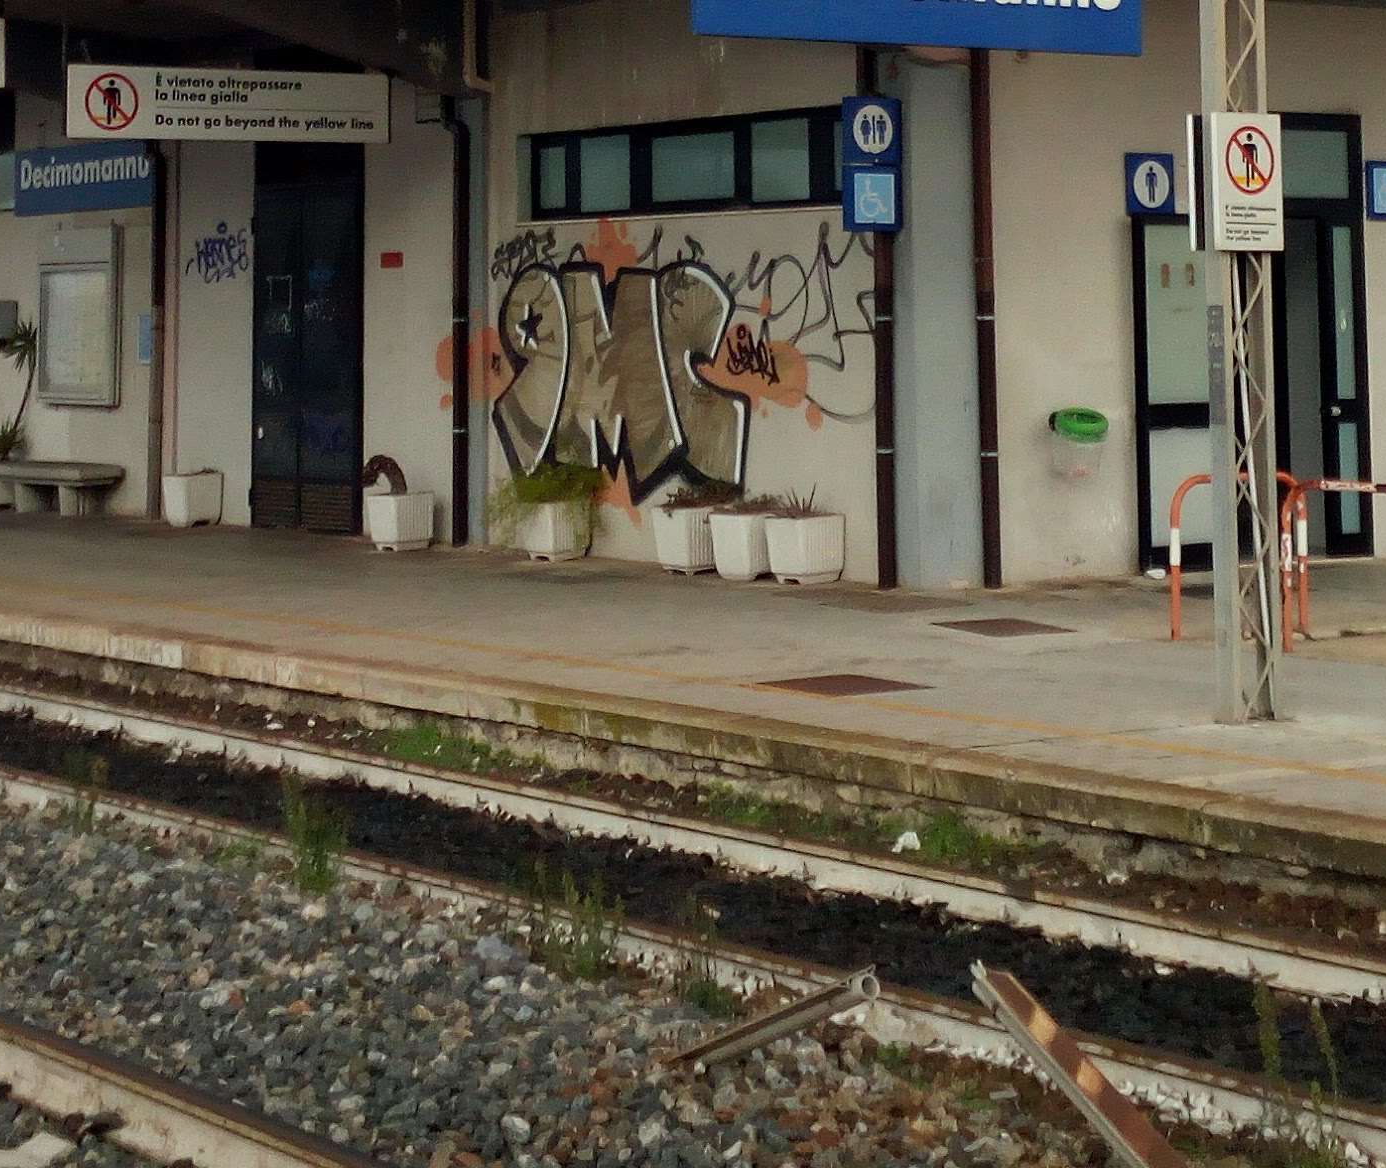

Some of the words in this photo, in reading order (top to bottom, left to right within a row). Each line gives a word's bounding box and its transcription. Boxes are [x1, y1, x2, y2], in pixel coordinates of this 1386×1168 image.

[166, 76, 214, 89] vietato
[218, 76, 303, 92] oltrepassare
[155, 89, 169, 102] la
[171, 90, 207, 102] linea
[210, 90, 249, 105] gialla
[154, 113, 174, 127] Do
[177, 116, 201, 127] not
[204, 117, 222, 129] go
[224, 114, 276, 131] beyond
[277, 116, 301, 129] the
[304, 116, 348, 132] yellow
[350, 117, 375, 131] line
[20, 155, 150, 191] Decimomannu
